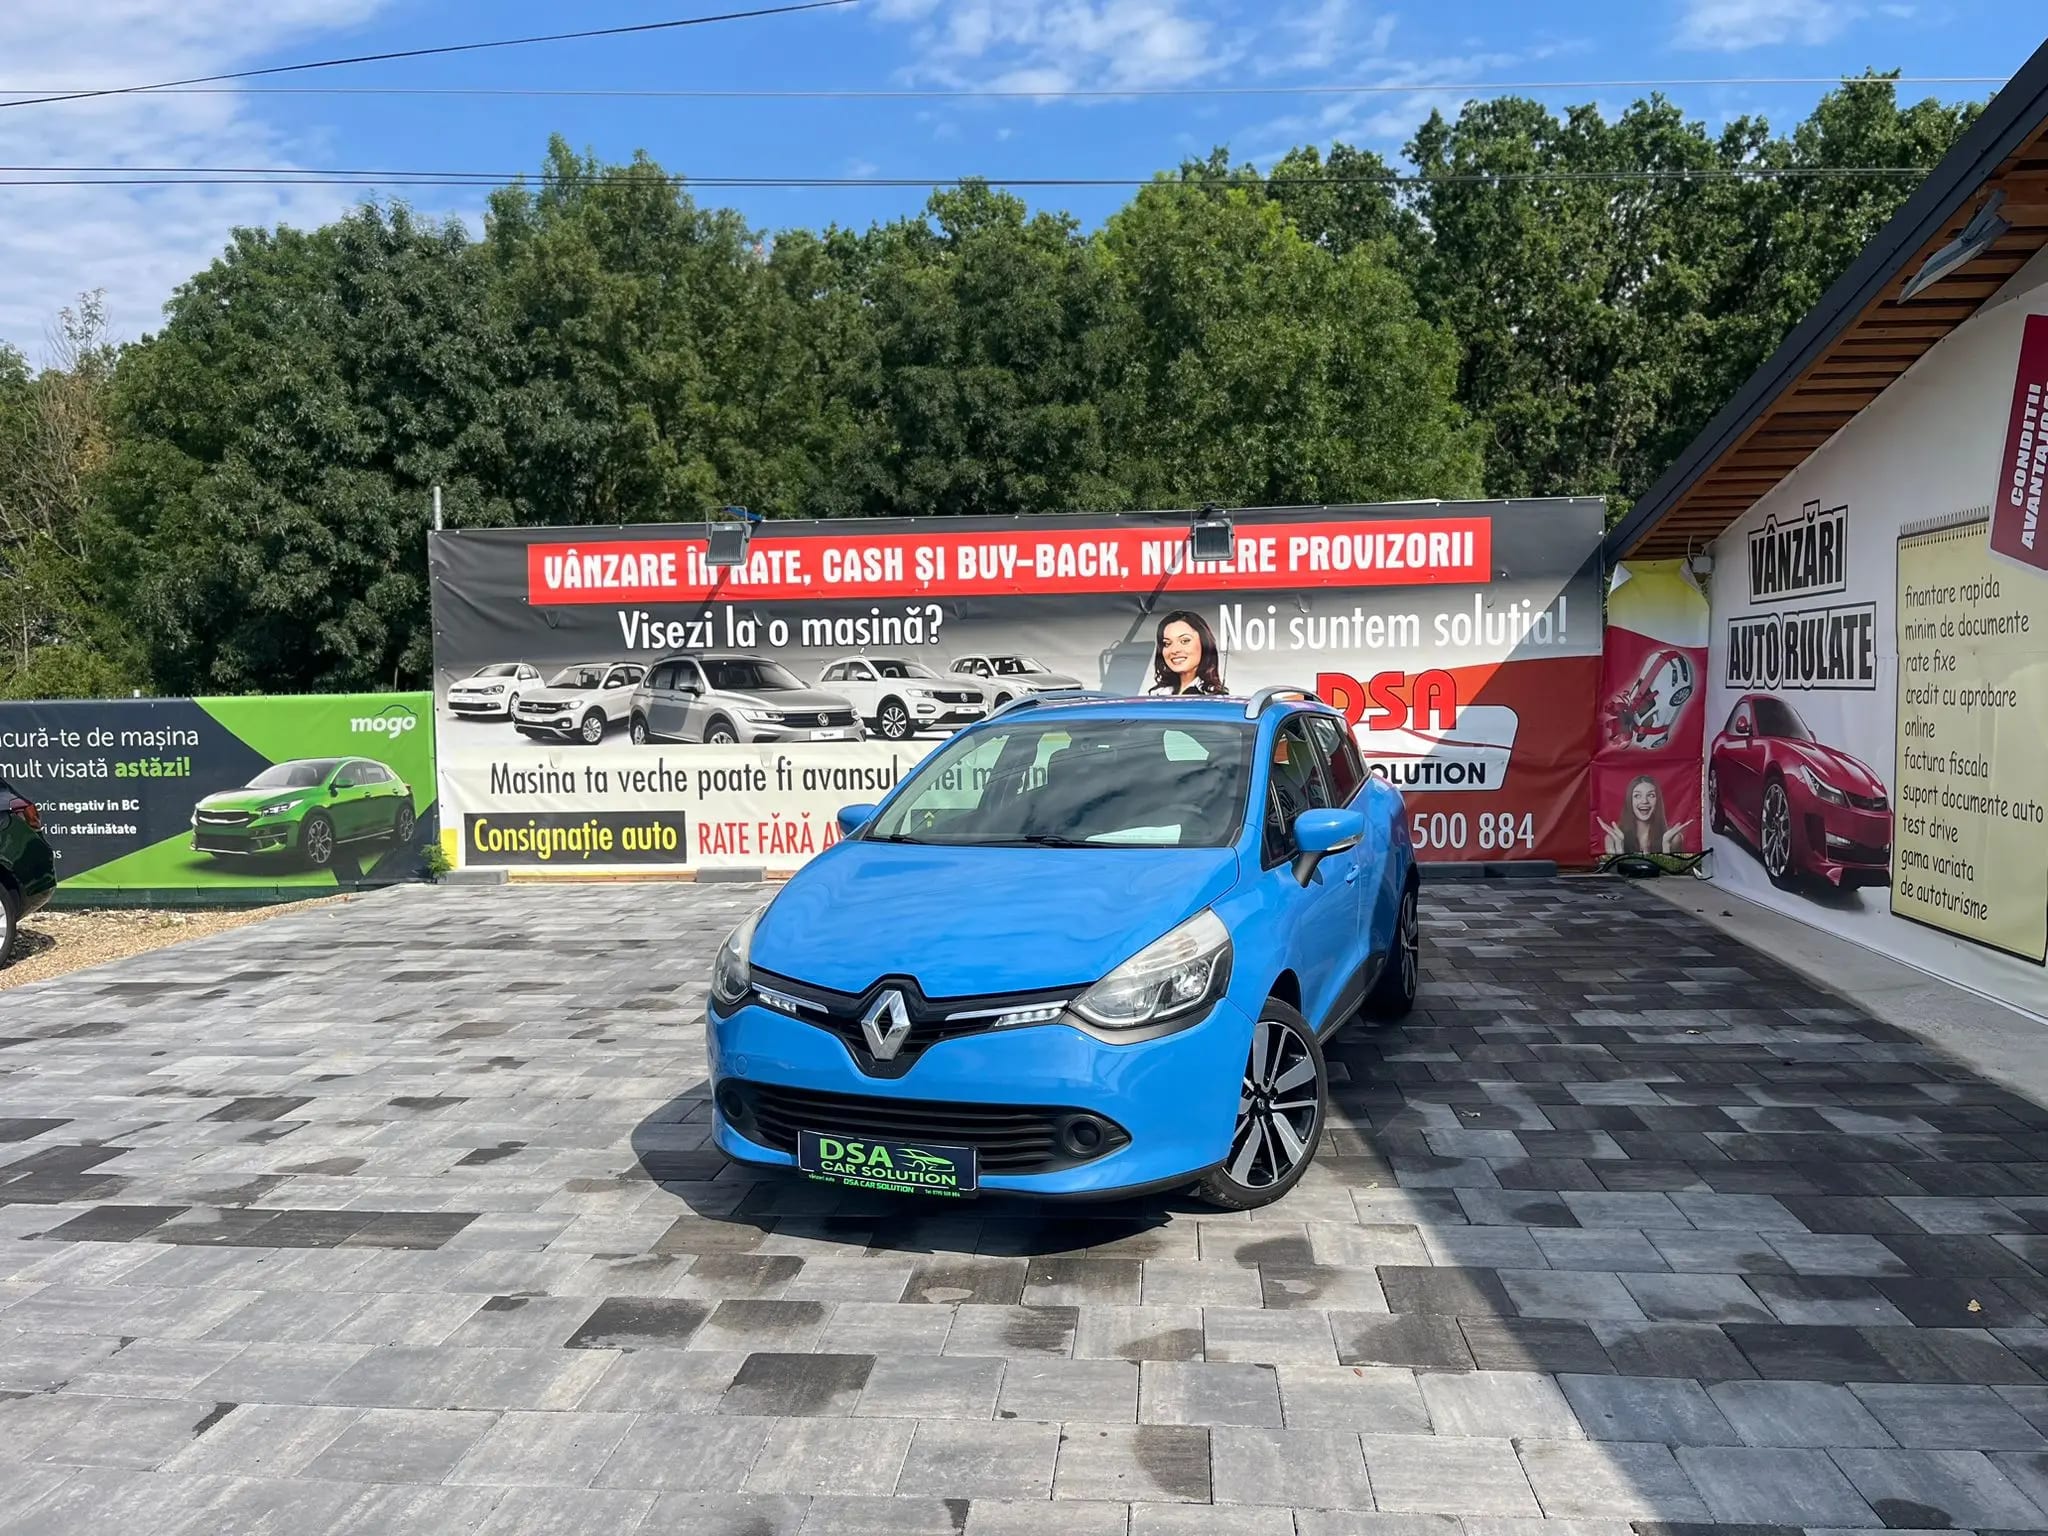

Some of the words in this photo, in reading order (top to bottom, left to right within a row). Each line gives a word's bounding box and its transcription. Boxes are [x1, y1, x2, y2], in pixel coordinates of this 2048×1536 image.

[544, 549, 677, 589] VÂNZARE
[730, 549, 812, 586] RATE,
[823, 547, 903, 583] CASH
[915, 545, 947, 588] ȘI
[958, 540, 1129, 581] BUY-BACK,
[1289, 531, 1474, 571] PROVIZORII
[1751, 510, 1844, 595] VÂNZĂRI
[1905, 584, 1956, 609] finantare
[1960, 573, 2001, 608] rapida
[617, 609, 714, 649] Visezi
[726, 604, 756, 648] la
[768, 619, 789, 647] o
[1219, 604, 1277, 651] Noi
[1289, 607, 1420, 650] suntem
[1433, 593, 1568, 648] solutia!
[1905, 617, 1937, 641] minim
[1940, 613, 1955, 638] de
[1958, 610, 2030, 637] documente
[1728, 622, 1779, 682] AUTO
[1785, 613, 1872, 682] RULATE
[1905, 652, 1930, 673] rate
[1933, 648, 1956, 673] fixe
[1316, 669, 1457, 731] DSA
[1905, 682, 1939, 705] credit
[1942, 688, 1957, 706] cu
[1960, 682, 2017, 714] aprobare
[87, 727, 114, 747] de
[121, 726, 199, 751] mașina
[350, 716, 417, 739] mogo
[1904, 715, 1936, 738] online
[47, 758, 108, 778] visată
[115, 756, 191, 777] astăzi!
[491, 763, 576, 794] Masina
[584, 766, 608, 793] ta
[617, 758, 688, 794] veche
[698, 765, 766, 801] poate
[776, 756, 793, 791] fi
[802, 754, 899, 791] avansul
[1371, 762, 1486, 785] OLUTION
[1904, 746, 1945, 773] factura
[1949, 750, 1989, 778] fiscala
[35, 800, 56, 811] oric
[59, 801, 106, 813] negativ
[122, 800, 139, 811] BC
[1902, 784, 1938, 808] suport
[1942, 784, 2009, 817] documente
[2012, 799, 2044, 823] auto
[50, 824, 68, 835] din
[70, 824, 137, 835] străinătate
[473, 818, 613, 860] Consignație
[621, 821, 679, 851] auto
[698, 821, 750, 854] RATE
[758, 812, 816, 854] FĂRĂ
[1478, 812, 1535, 849] 884
[1902, 813, 1926, 836] test
[1929, 816, 1959, 843] drive
[1901, 849, 1929, 870] gama
[1932, 855, 1974, 881] variata
[1900, 875, 1914, 898] de
[1917, 884, 1988, 920] autoturisme
[819, 1138, 894, 1168] DSA
[821, 1161, 856, 1175] CAR
[862, 1166, 956, 1186] SOLUTION
[843, 1178, 859, 1187] DSA
[860, 1180, 875, 1189] CAR
[876, 1182, 914, 1193] SOLUTION
